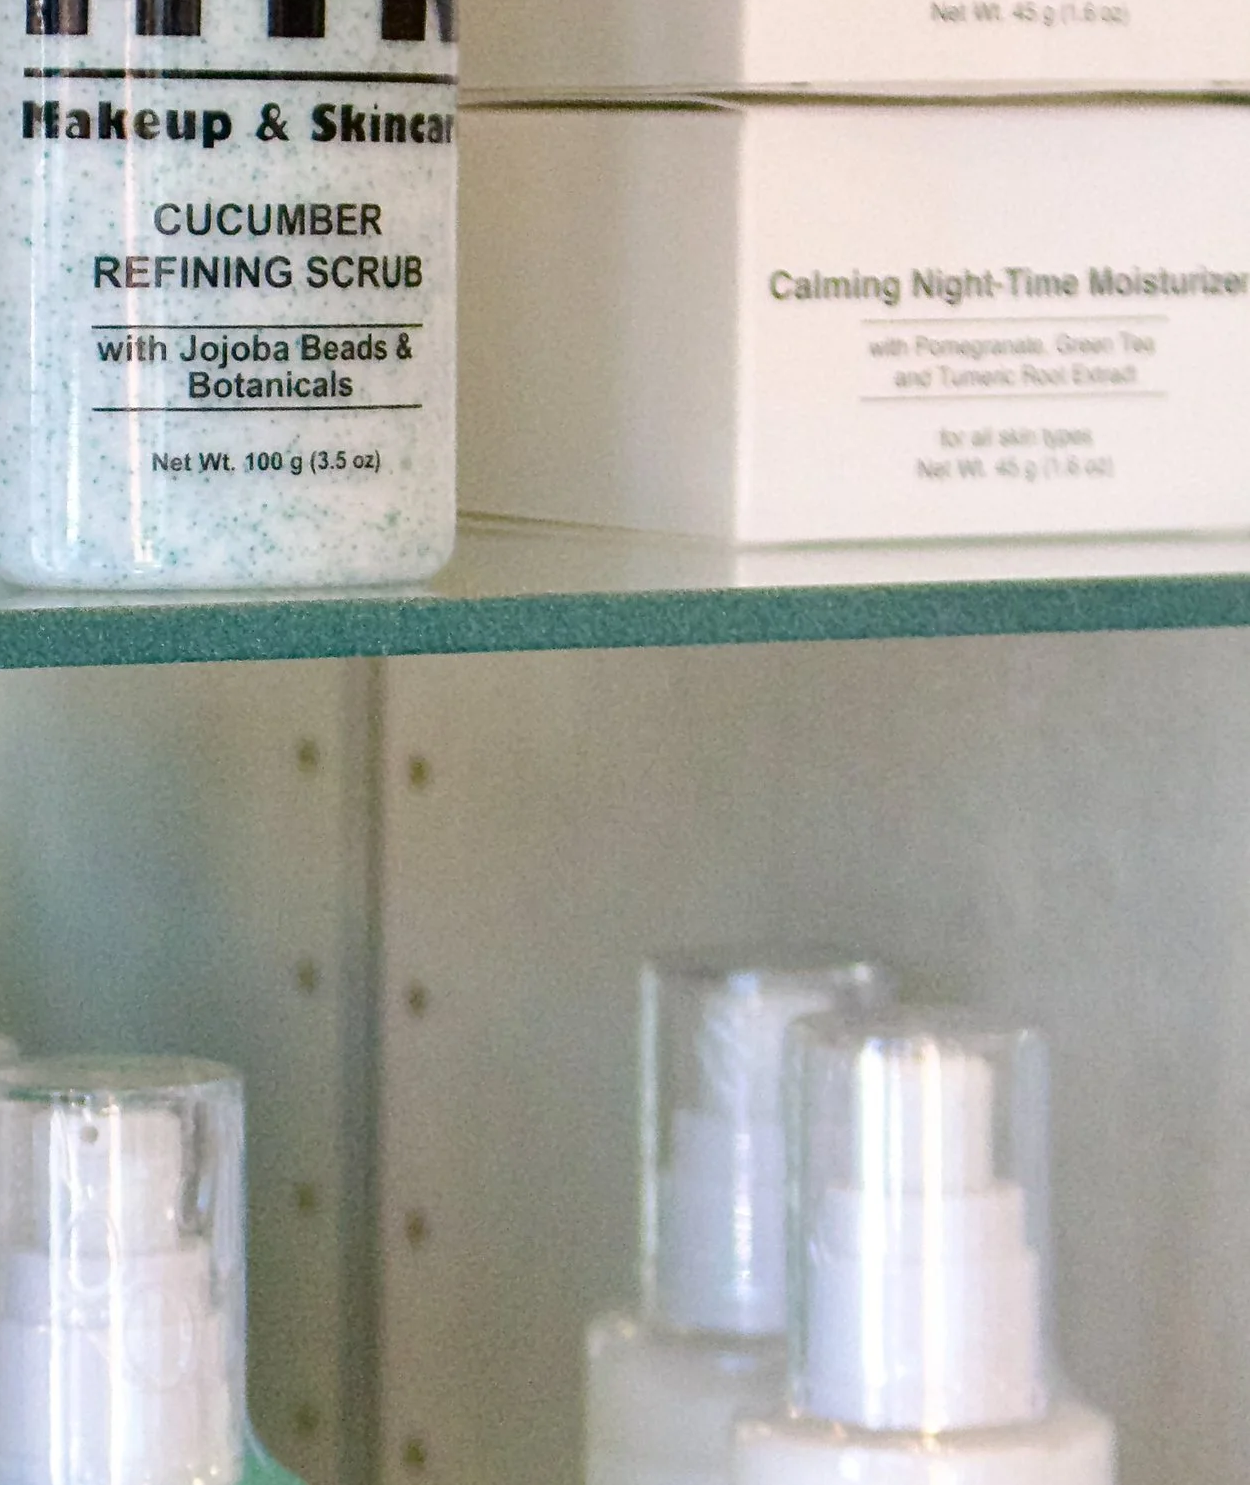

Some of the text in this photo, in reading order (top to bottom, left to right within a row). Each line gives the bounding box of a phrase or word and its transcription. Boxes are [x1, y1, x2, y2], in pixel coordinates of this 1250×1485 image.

[22, 100, 233, 150] Makeup
[255, 102, 290, 143] &
[154, 202, 383, 237] CUCUMBER
[94, 255, 423, 290] REFINING SCRUB
[769, 268, 901, 307] Calming
[912, 266, 1078, 306] Night-Time
[96, 332, 413, 369] with Jojoba Beads &
[188, 369, 354, 399] Botanicals
[152, 449, 382, 477] Net Wt. 100 g (3.5 oz)
